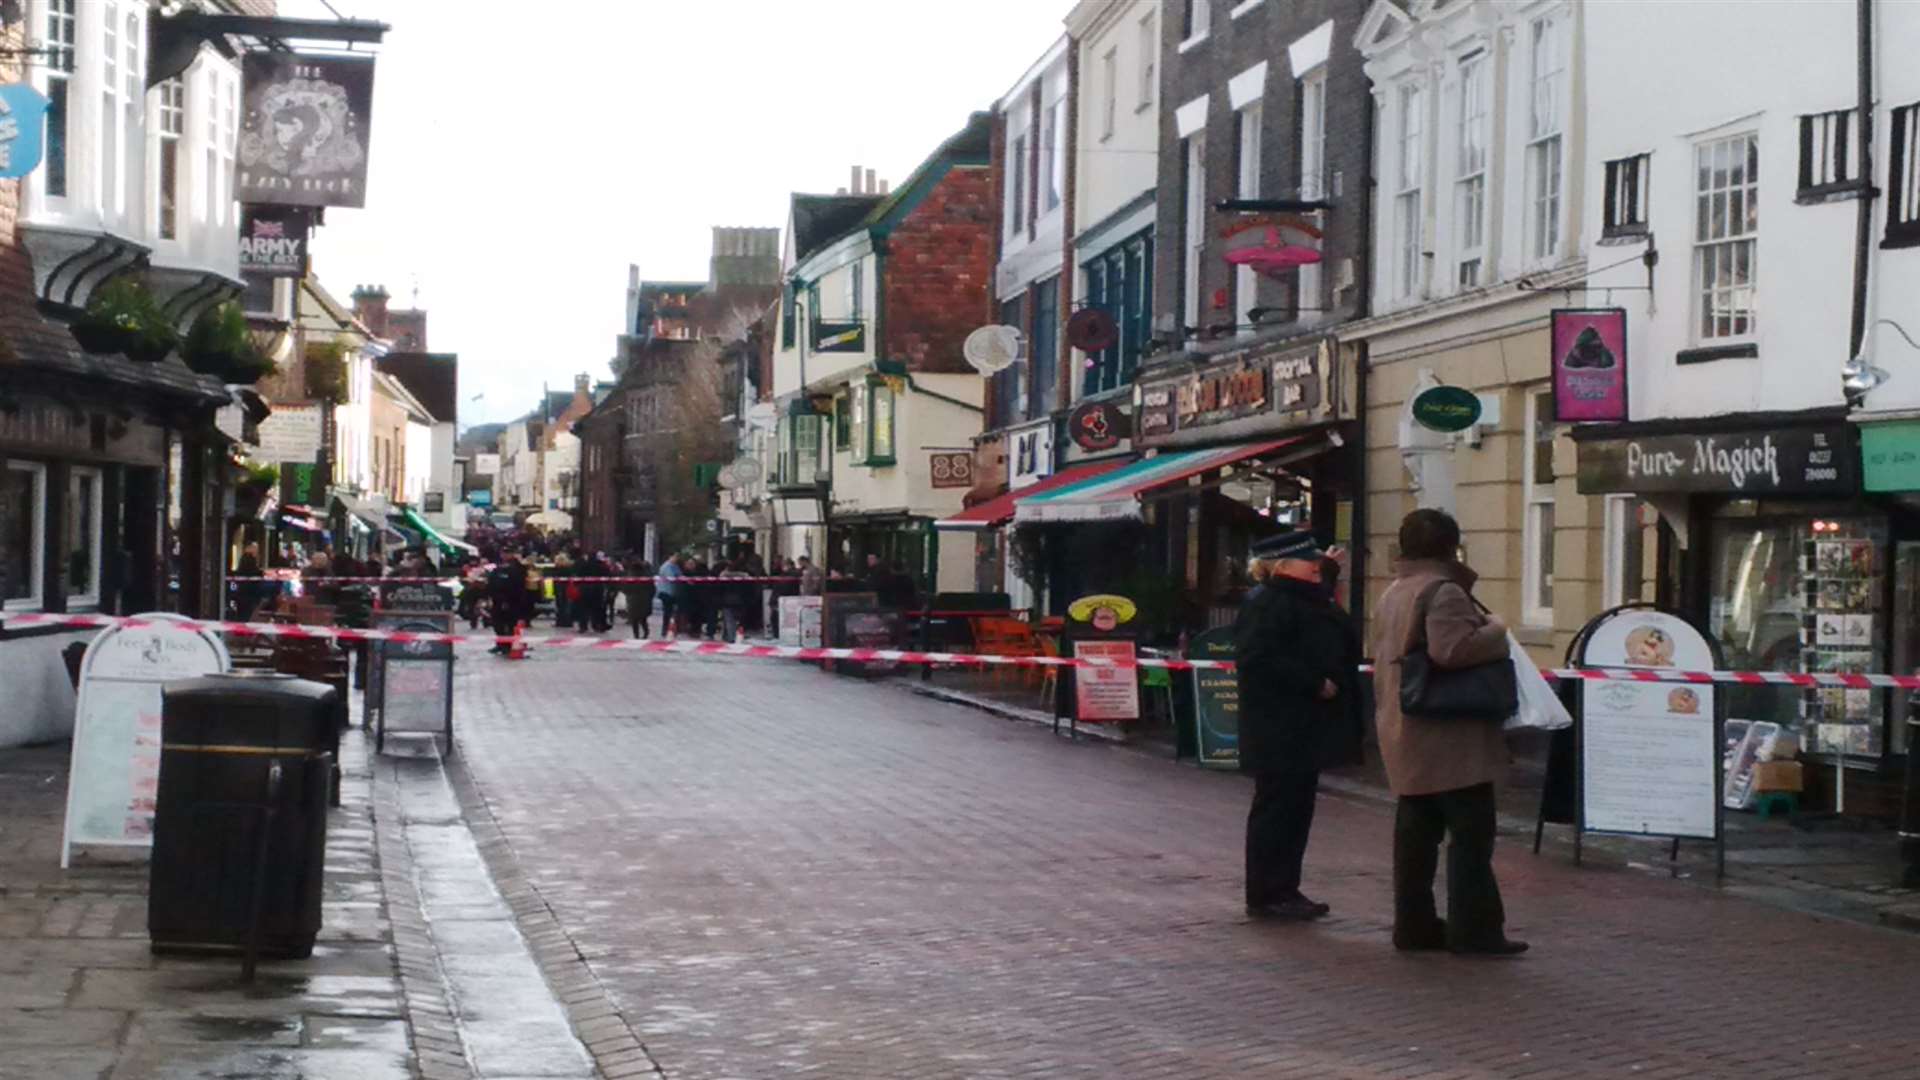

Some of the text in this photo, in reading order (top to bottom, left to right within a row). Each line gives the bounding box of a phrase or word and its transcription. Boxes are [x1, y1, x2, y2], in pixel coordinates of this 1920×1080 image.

[240, 236, 300, 255] ARMY
[933, 455, 969, 479] 88
[1692, 435, 1780, 488] Magick
